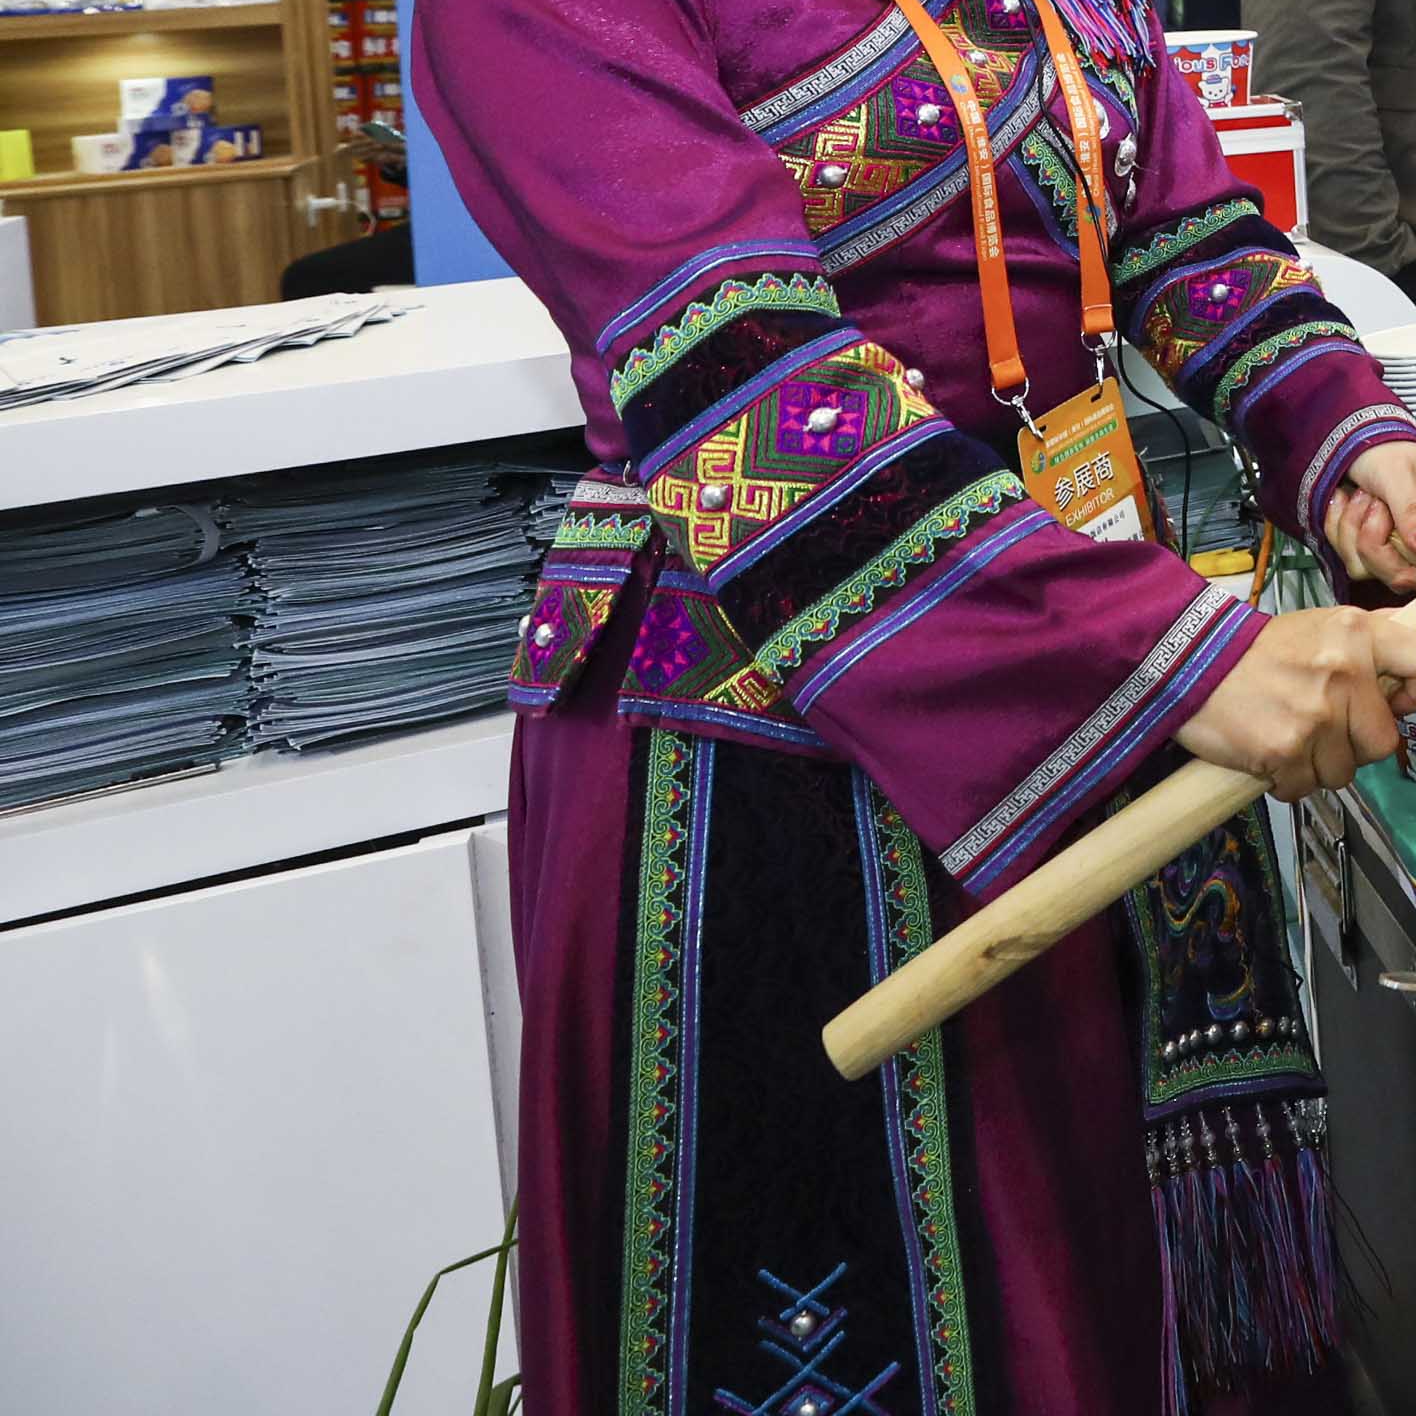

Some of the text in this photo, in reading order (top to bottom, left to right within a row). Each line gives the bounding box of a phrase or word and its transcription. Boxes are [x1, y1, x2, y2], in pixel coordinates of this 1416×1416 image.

[1054, 450, 1115, 511] 参展商
[1064, 487, 1116, 528] EXHIBITOR
